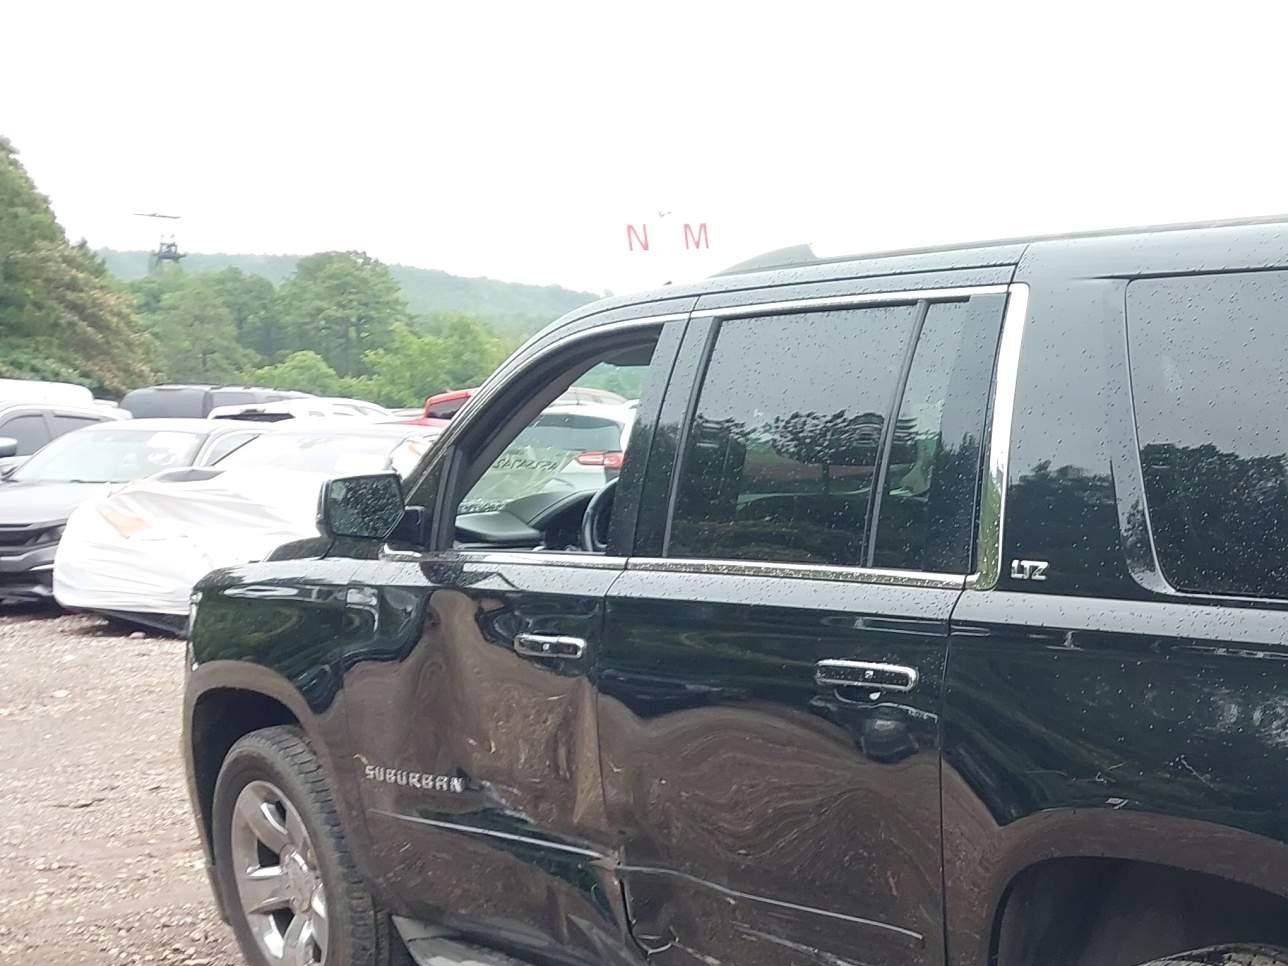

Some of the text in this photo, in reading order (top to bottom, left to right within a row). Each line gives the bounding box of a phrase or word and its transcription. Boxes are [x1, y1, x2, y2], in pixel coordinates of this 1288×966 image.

[626, 222, 709, 252] N M
[1010, 559, 1049, 580] LTZ
[364, 765, 465, 793] SUBURBAN
